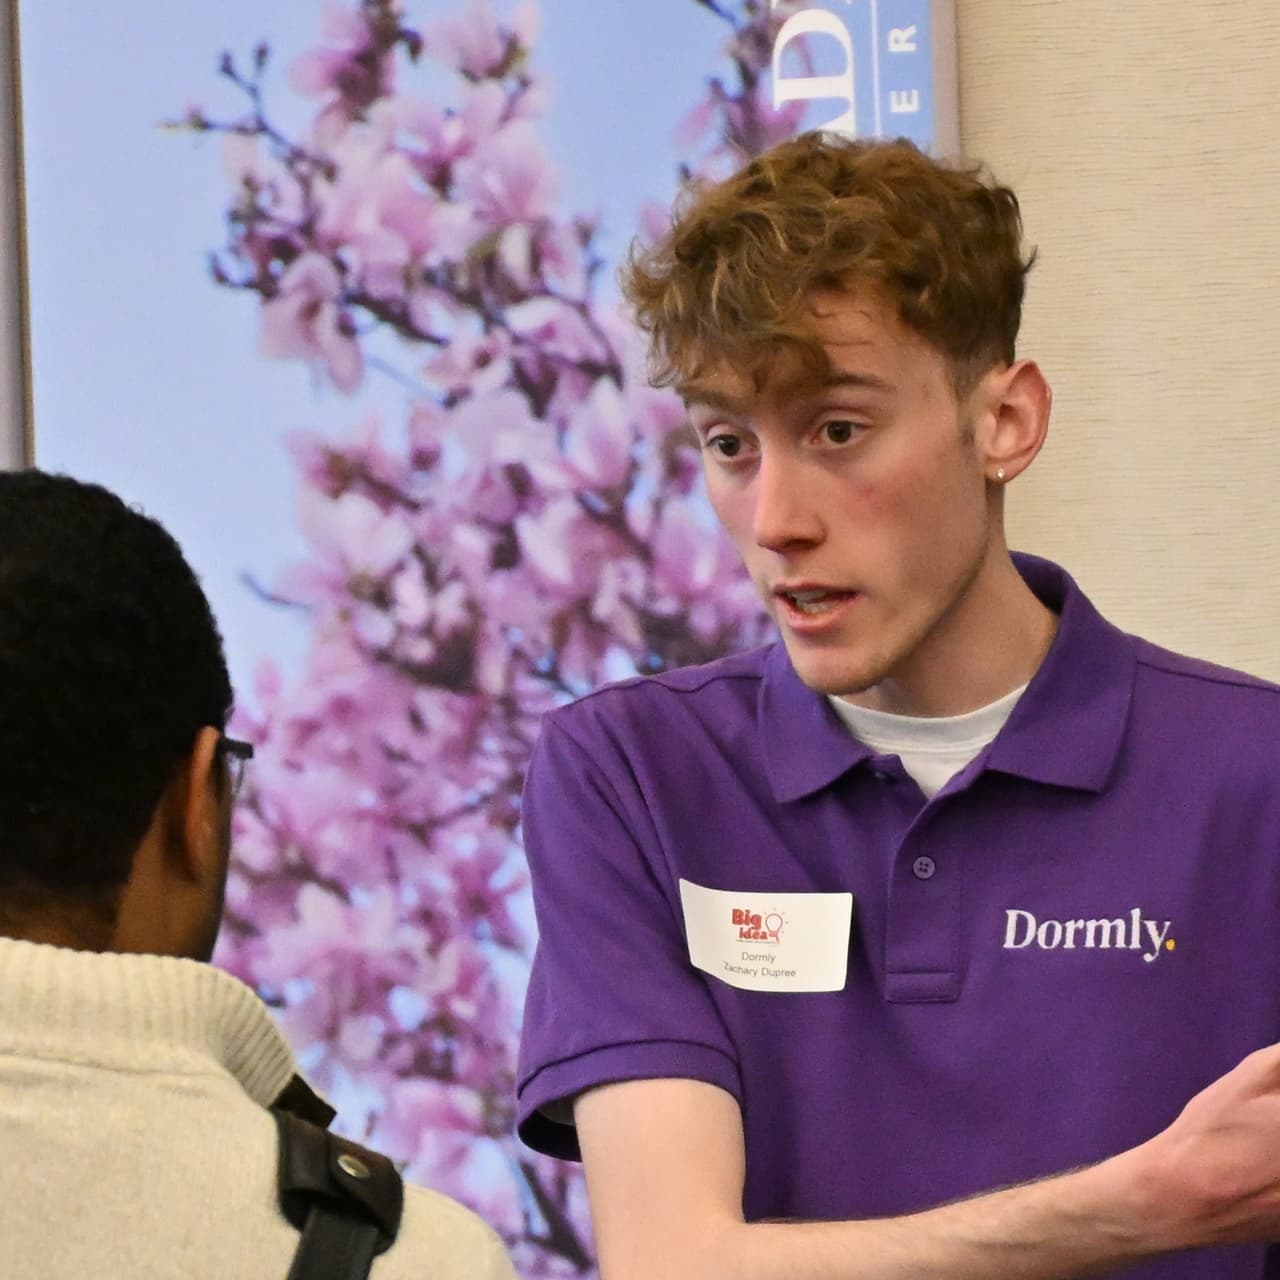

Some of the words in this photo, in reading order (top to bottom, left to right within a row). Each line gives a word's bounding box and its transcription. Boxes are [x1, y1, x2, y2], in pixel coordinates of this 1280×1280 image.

[731, 908, 763, 930] Big
[1002, 907, 1176, 963] Dormly.
[741, 951, 777, 964] Dormly
[723, 961, 758, 977] Zachary
[761, 967, 797, 979] Dupree
